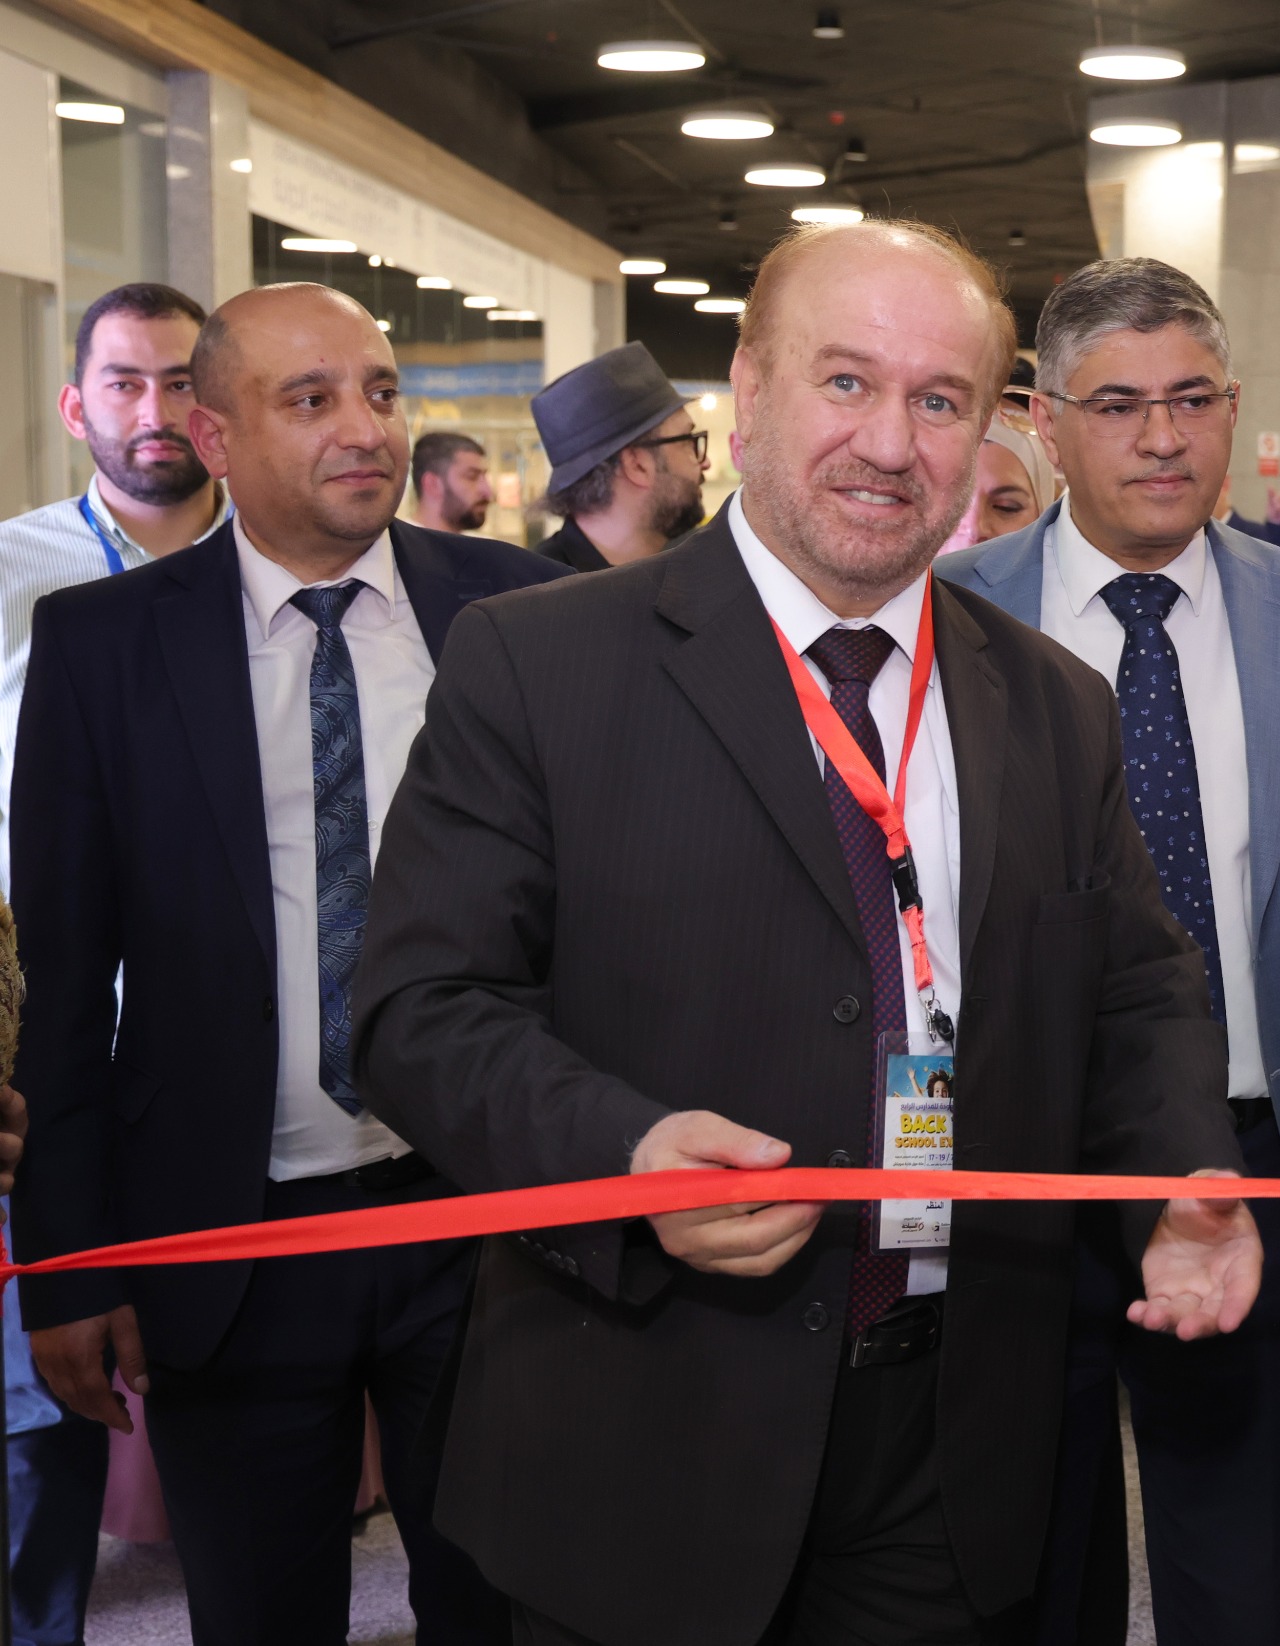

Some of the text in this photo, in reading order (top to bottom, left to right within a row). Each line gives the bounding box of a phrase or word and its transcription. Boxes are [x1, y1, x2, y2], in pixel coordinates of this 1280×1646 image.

[900, 1102, 916, 1111] الرابع
[916, 1102, 939, 1111] للمدارس
[900, 1113, 947, 1134] BACK
[895, 1136, 937, 1148] SCHOOL
[925, 1200, 945, 1212] المنظم
